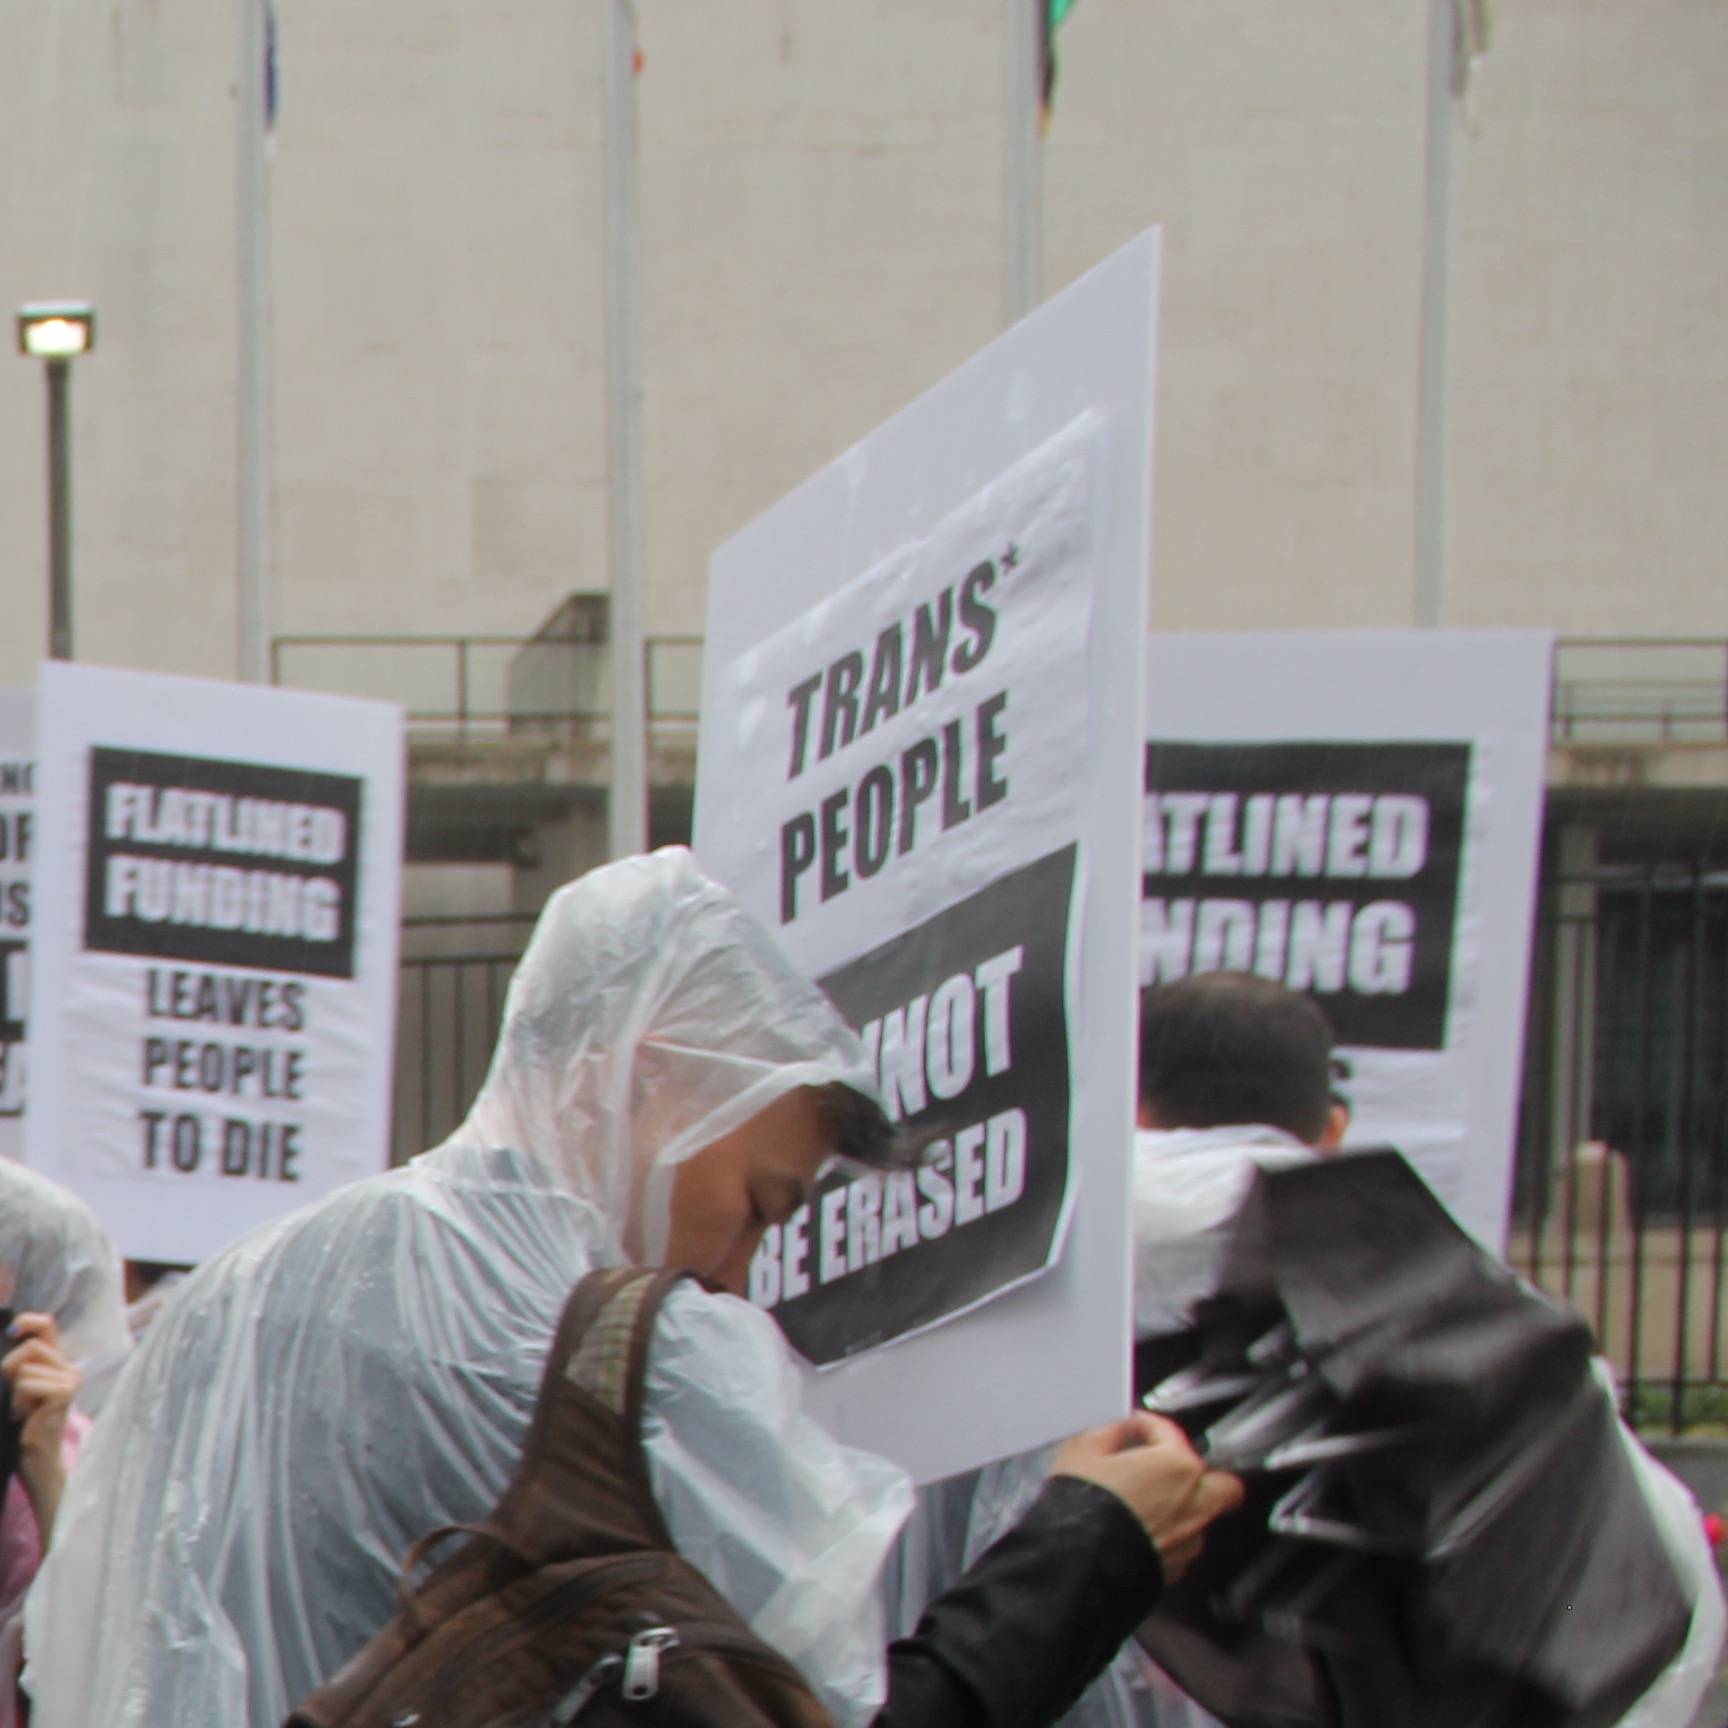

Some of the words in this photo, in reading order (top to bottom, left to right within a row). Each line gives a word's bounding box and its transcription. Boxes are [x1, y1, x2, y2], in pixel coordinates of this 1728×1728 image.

[104, 781, 347, 864] FLATLINED
[781, 689, 1010, 926] PEOPLE
[103, 854, 341, 942] FUNDING
[146, 969, 306, 1034] LEAVES
[144, 1036, 306, 1100] PEOPLE
[140, 1110, 201, 1173] TO
[220, 1116, 301, 1182] DIE
[749, 1203, 810, 1310] BE
[819, 1107, 1028, 1285] ERASED
